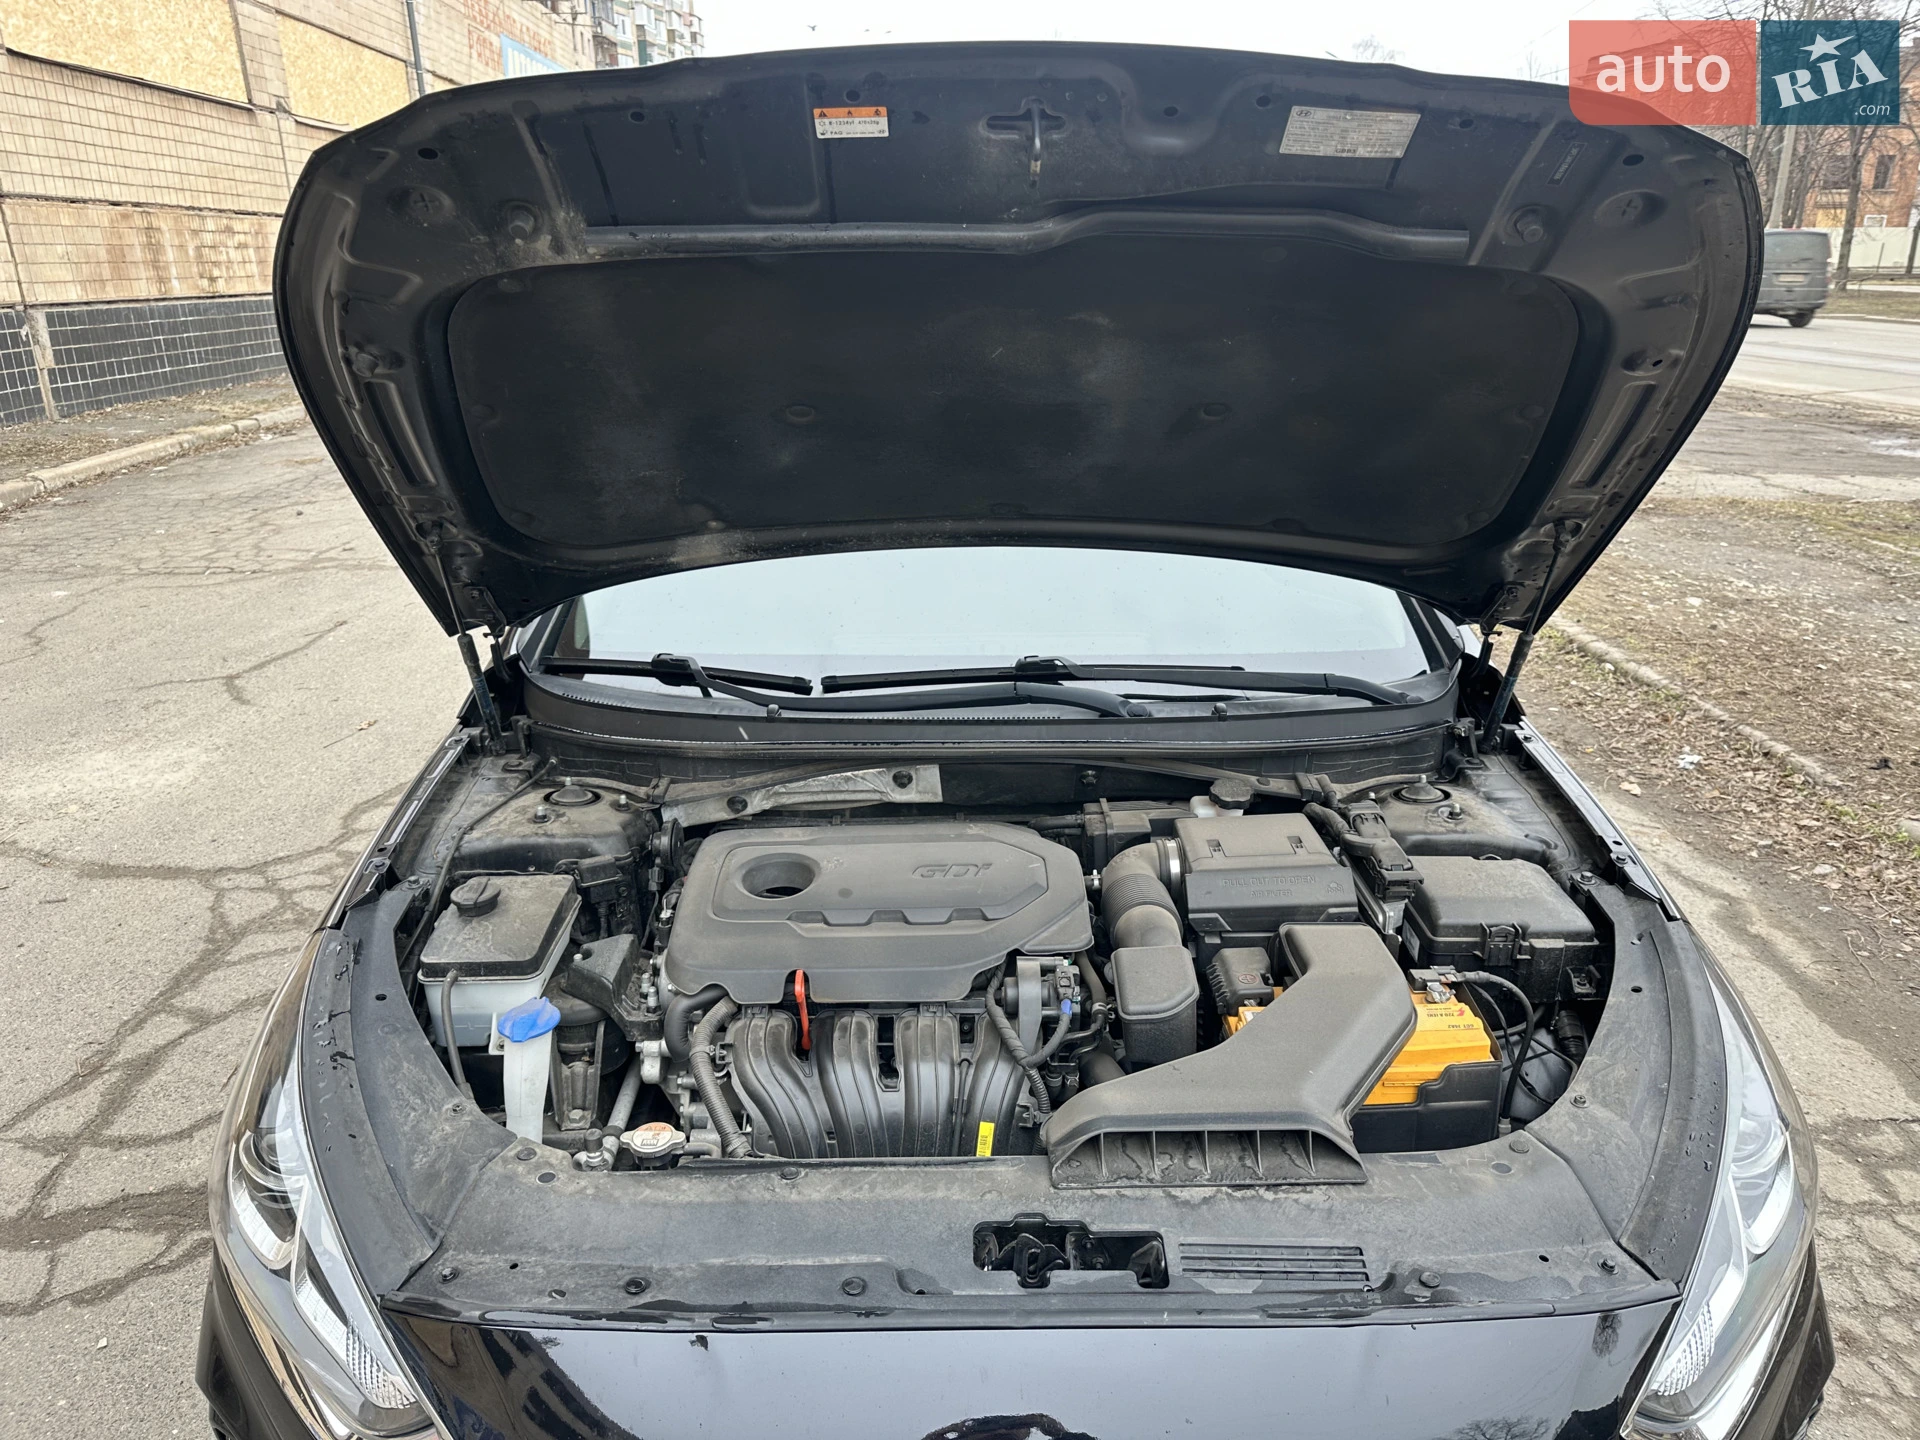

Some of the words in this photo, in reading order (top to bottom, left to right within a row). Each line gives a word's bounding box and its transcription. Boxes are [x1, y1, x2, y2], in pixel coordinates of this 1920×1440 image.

[1222, 879, 1248, 888] PULL
[1250, 877, 1270, 887] OUT
[1273, 876, 1287, 885] TO
[1288, 874, 1316, 884] OPEN
[1250, 890, 1264, 898] AIR
[1265, 889, 1293, 898] FILTER
